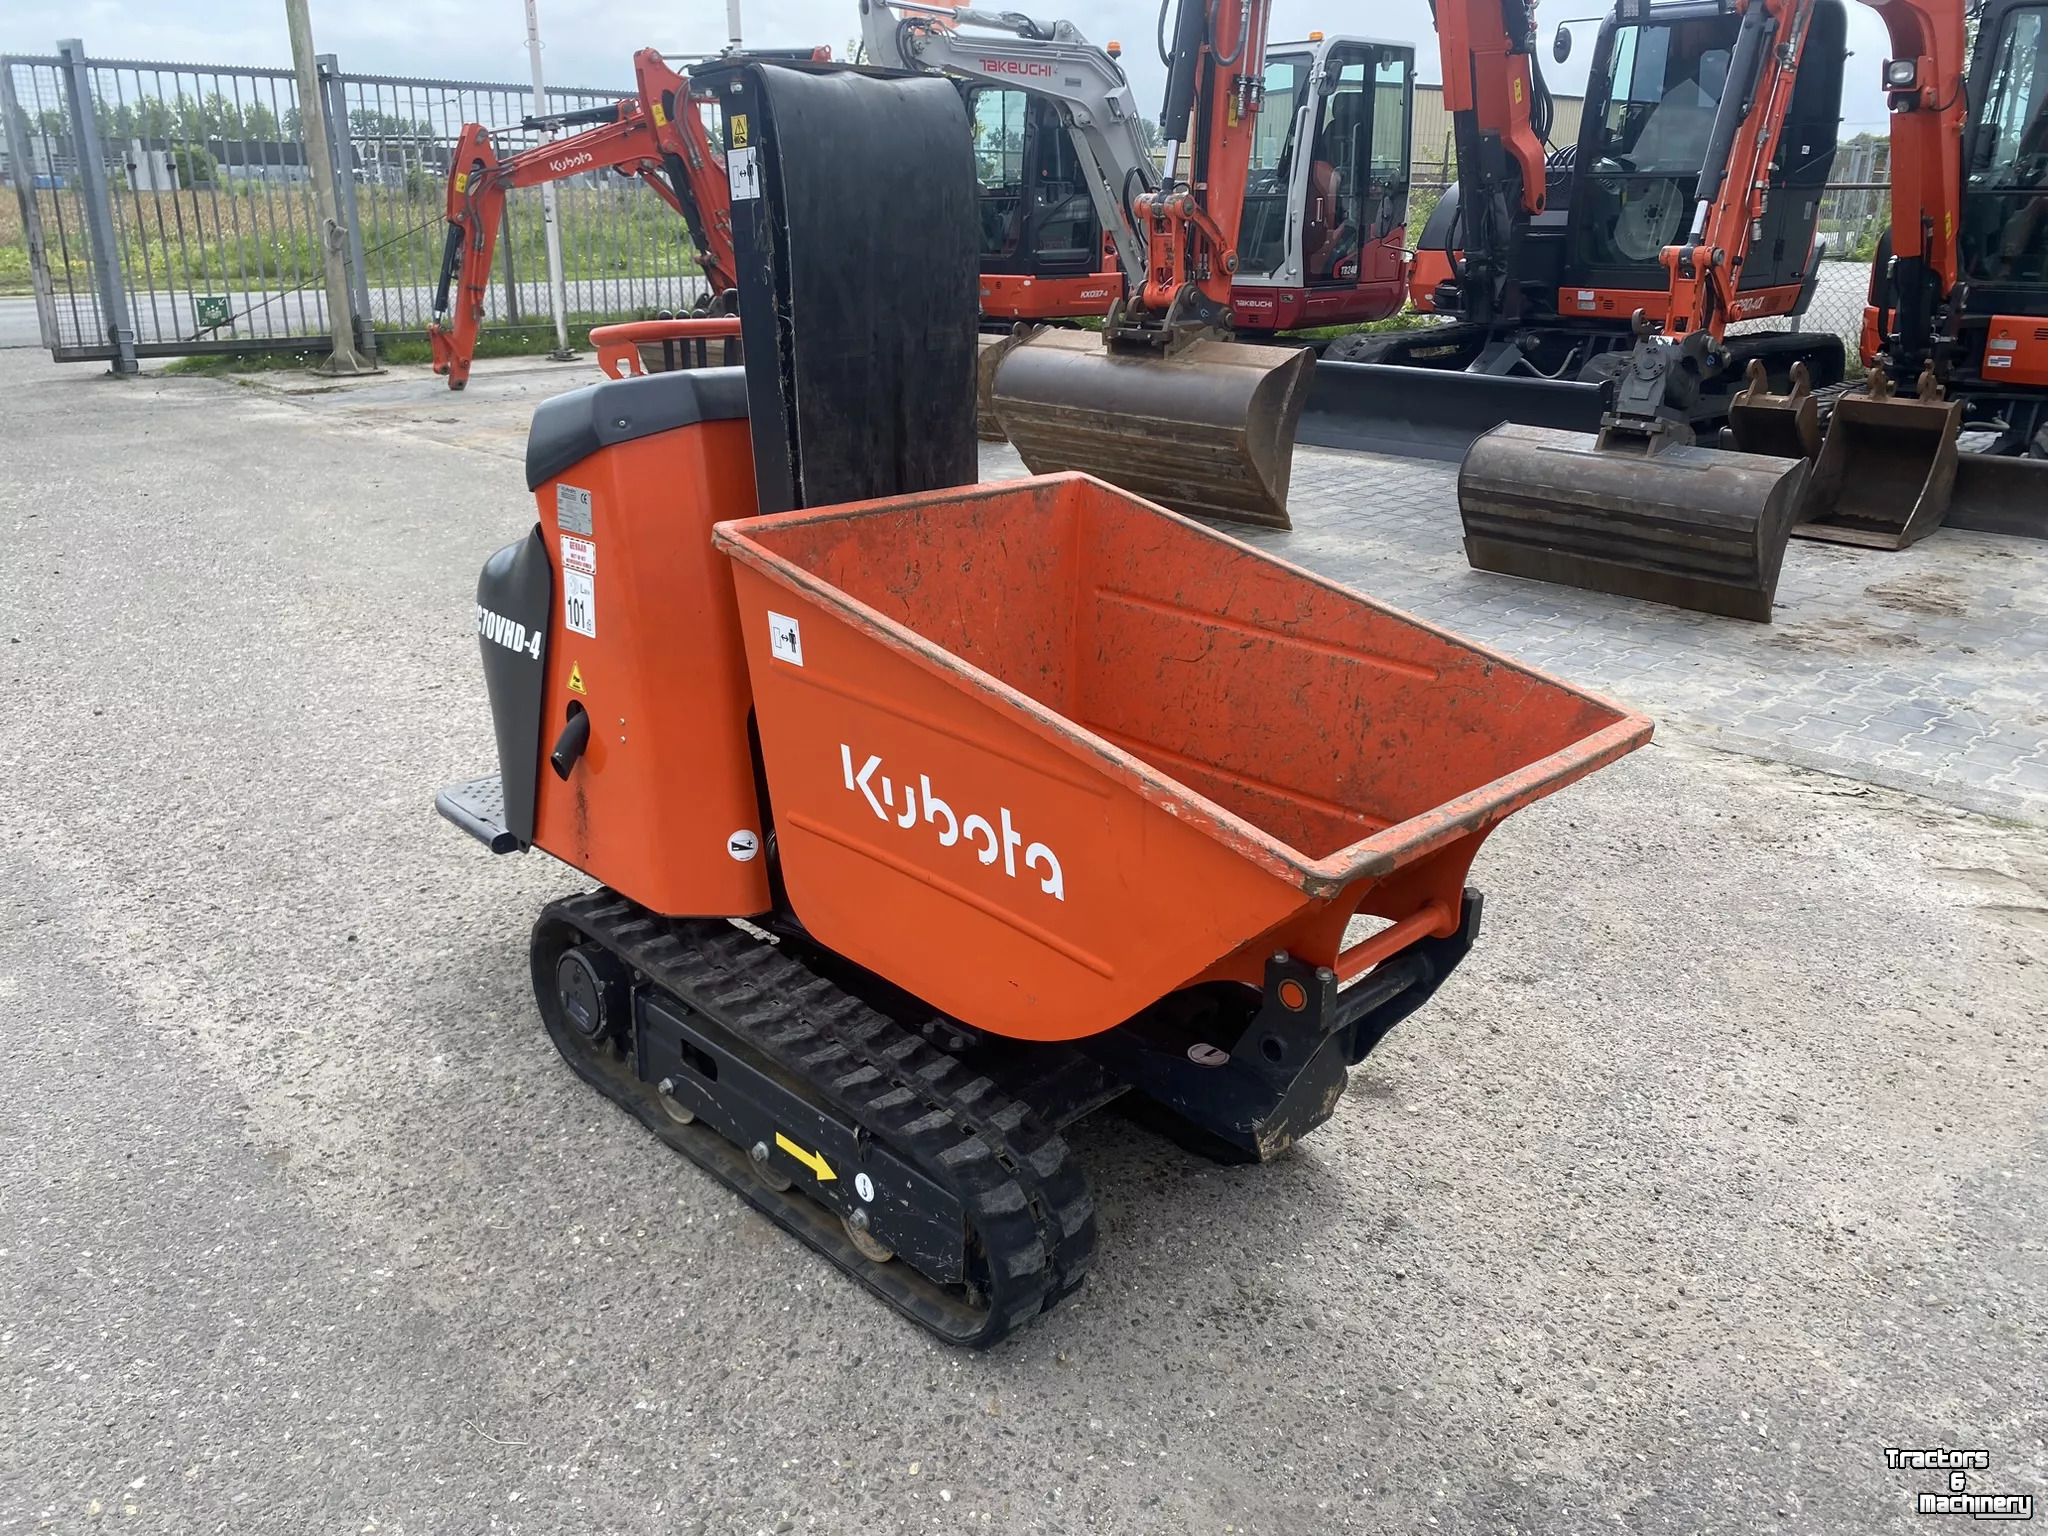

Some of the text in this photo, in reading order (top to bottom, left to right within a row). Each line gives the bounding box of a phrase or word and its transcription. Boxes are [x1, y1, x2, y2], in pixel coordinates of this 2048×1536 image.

[549, 152, 593, 172] Kubota
[568, 595, 585, 629] 101
[840, 743, 1065, 902] Kubota
